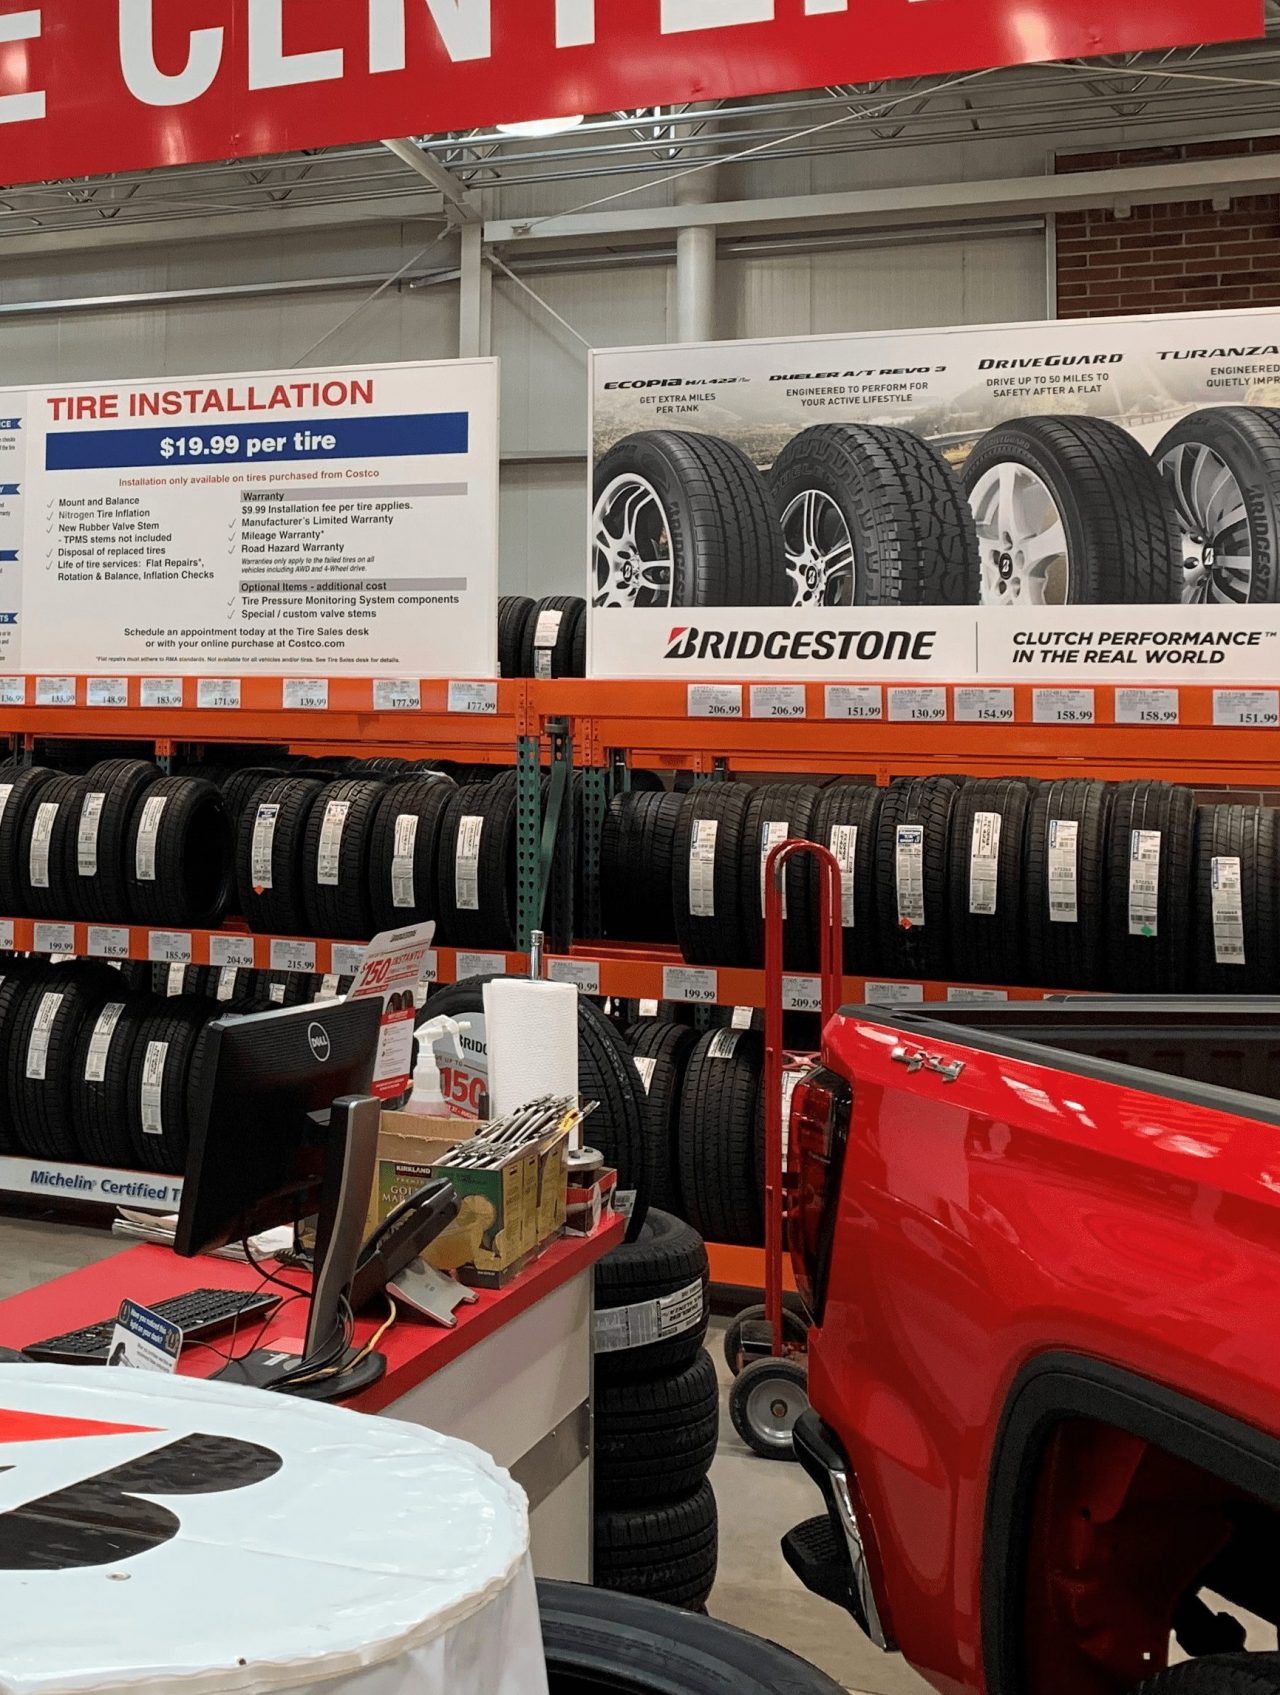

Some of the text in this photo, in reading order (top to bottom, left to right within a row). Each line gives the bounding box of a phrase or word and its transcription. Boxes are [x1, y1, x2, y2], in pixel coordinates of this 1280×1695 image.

[769, 371, 839, 381] DUELER
[843, 369, 877, 377] A/T
[879, 366, 930, 375] REVO
[986, 373, 1109, 387] DRIVE UP TO 50 MILES TO
[1206, 378, 1251, 388] QUIETLY
[786, 381, 929, 397] ENGINEERED TO PERFORM FOR
[993, 385, 1102, 398] SAFETY AFTER A FLAT
[47, 379, 373, 421] TIRE INSTALLATION
[639, 393, 716, 404] GET EXTRA MILES
[801, 394, 913, 407] YOUR ACTIVE LIFESTYLE
[656, 405, 699, 414] PER TANK
[160, 431, 336, 459] $19.99 per tire
[119, 468, 380, 487] Installation only available on tires purchased from Costco
[59, 497, 140, 507] Mount and Balance
[243, 492, 285, 502] Warranty
[242, 501, 413, 515] $9.99 Installation fee per tire applies.
[59, 509, 150, 520] Nitrogen Tire Inflation
[242, 515, 394, 527] Manufacturer's Limited Warranty
[242, 532, 276, 541] Mileage
[58, 547, 165, 557] Disposal of replaced tires
[242, 543, 344, 553] Road Hazard Warranty
[242, 594, 459, 606] Tire Pressure Monitoring System components
[664, 626, 937, 660] BRIDGESTONE
[1013, 631, 1093, 646] CLUTCH
[1012, 650, 1226, 664] IN THE REAL WORLD
[213, 697, 239, 707] 171.99
[391, 698, 420, 709] 177.99
[708, 705, 741, 716] 206.99
[770, 705, 805, 716] 206.99
[847, 706, 881, 718] 151.99
[910, 708, 946, 720] 130.99
[977, 709, 1013, 720] 154.99
[1056, 710, 1093, 722] 158.99
[1140, 711, 1177, 722] 158.99
[1239, 713, 1278, 724] 151.99
[49, 941, 74, 951] 199.99
[226, 955, 253, 966] 204.99
[287, 959, 315, 970] 215.99
[683, 988, 716, 1001] 199.99
[310, 1035, 329, 1049] DELL
[396, 1165, 431, 1174] KIRKLAND
[100, 1178, 168, 1202] Certified
